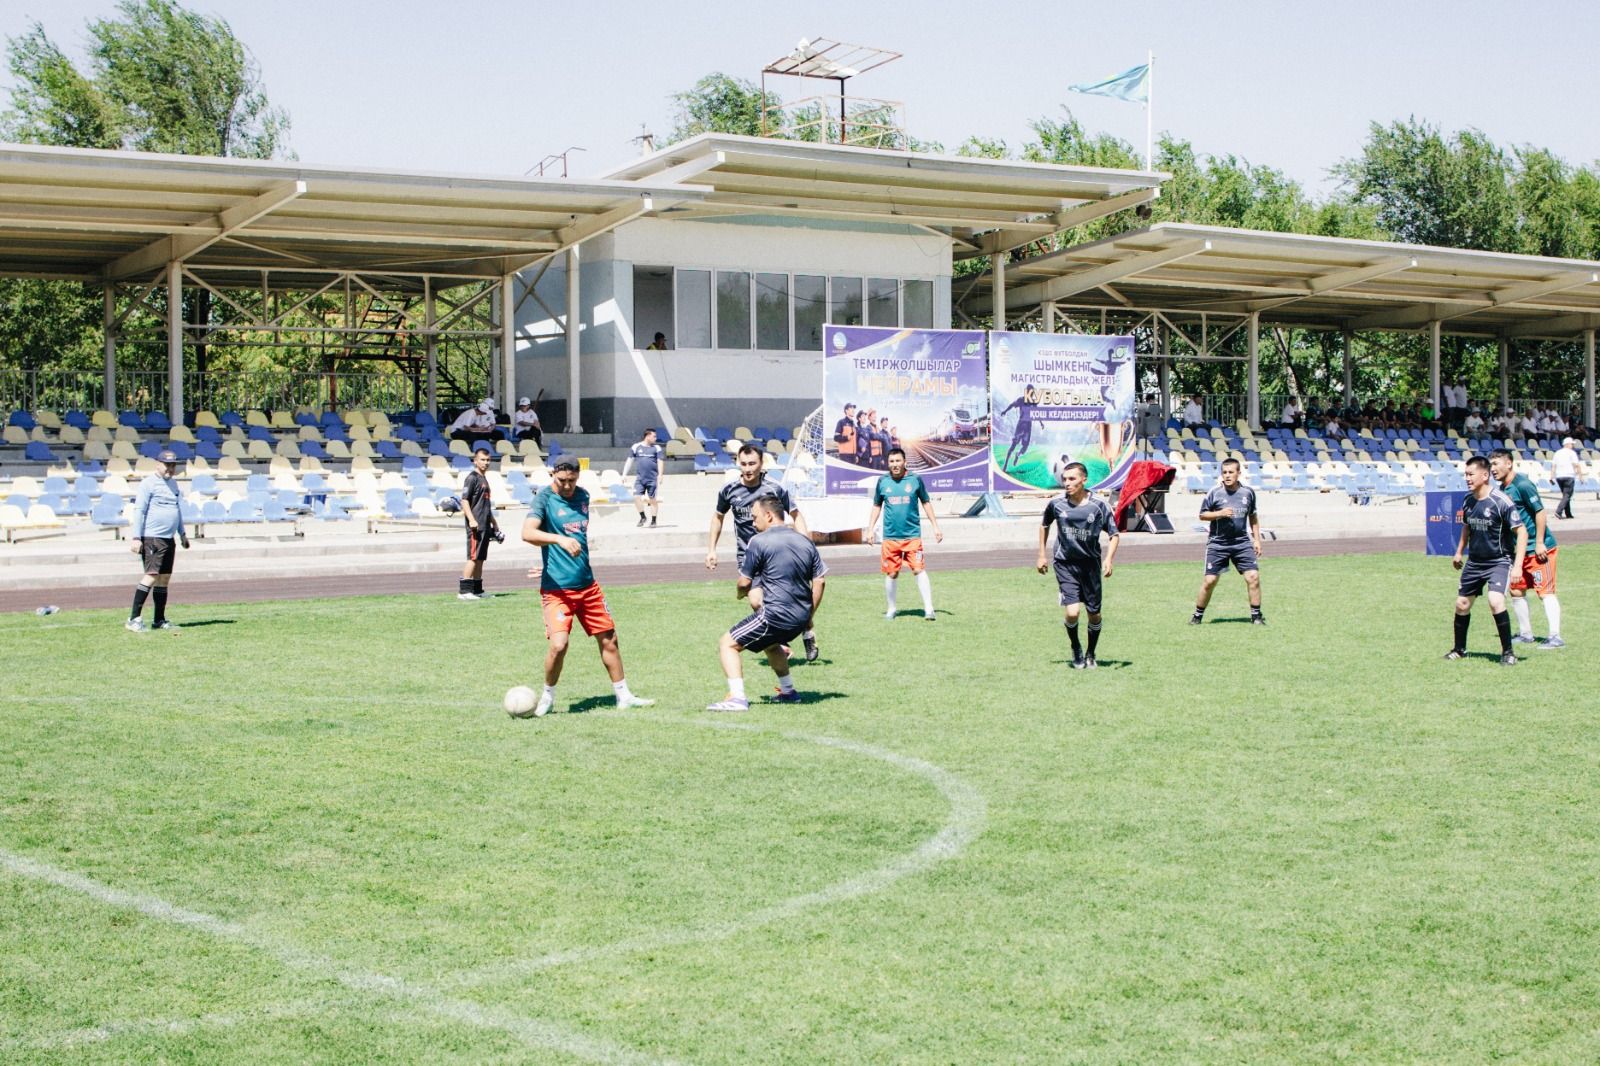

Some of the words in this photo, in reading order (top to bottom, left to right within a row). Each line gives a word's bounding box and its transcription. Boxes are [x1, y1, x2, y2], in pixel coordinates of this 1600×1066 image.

[852, 358, 961, 372] ТЕМІРЖОЛШЫЛАР
[1033, 359, 1092, 372] ШЫМКЕНТ
[856, 371, 959, 396] МЕЙРАМЫ
[1011, 373, 1090, 386] МАГИСТРАЛЬДЫҚ
[1092, 375, 1116, 385] ЖЕЛІ
[1024, 388, 1104, 406] КУБОГЫНА
[1029, 410, 1047, 420] ҚОШ
